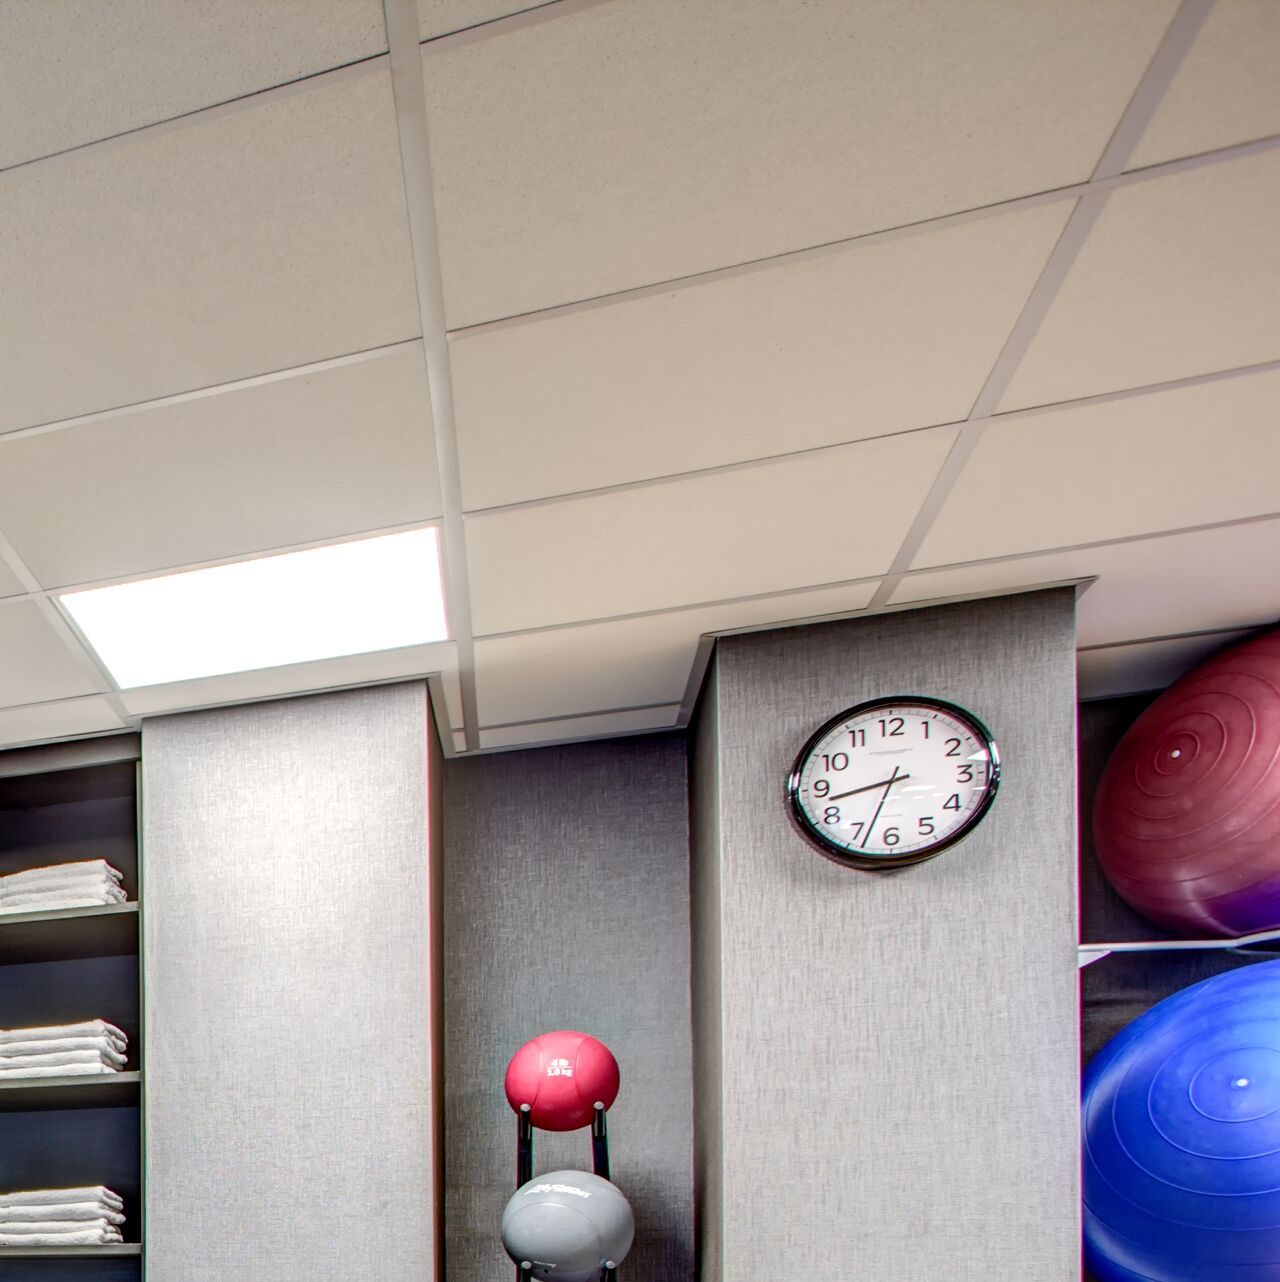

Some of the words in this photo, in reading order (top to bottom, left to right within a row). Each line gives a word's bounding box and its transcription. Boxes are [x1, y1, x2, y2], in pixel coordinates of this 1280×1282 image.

[878, 718, 905, 737] 12
[921, 721, 930, 739] 1
[849, 729, 867, 748] 11
[944, 738, 962, 757] 2
[822, 752, 849, 772] 10
[956, 764, 973, 783] 3
[813, 780, 830, 798] 9
[942, 794, 962, 812] 4
[824, 806, 841, 825] 8
[851, 822, 865, 841] 7
[918, 817, 935, 836] 5
[883, 827, 900, 846] 6
[551, 1058, 558, 1067] 4
